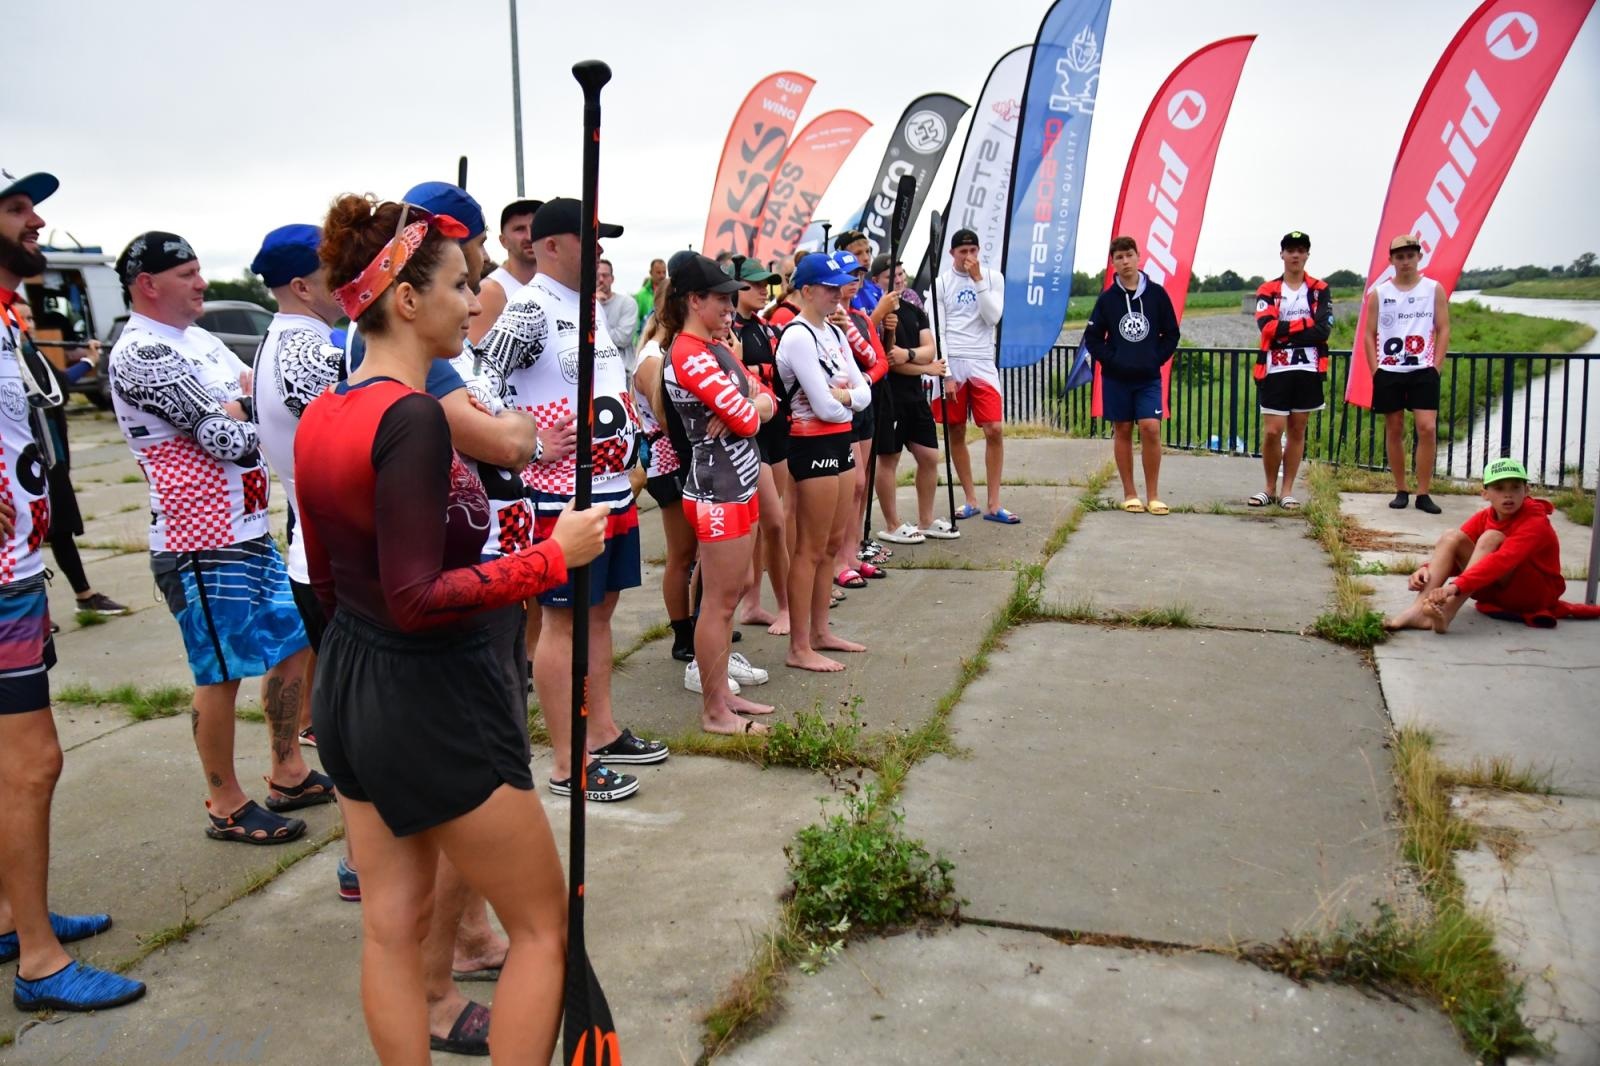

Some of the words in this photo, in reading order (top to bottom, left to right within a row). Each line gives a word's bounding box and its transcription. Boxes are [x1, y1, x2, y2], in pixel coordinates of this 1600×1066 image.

[775, 77, 803, 95] SUP
[762, 97, 798, 121] WING
[1367, 67, 1501, 295] apid
[762, 161, 804, 239] BASS
[1051, 196, 1069, 292] INNOVATION
[1062, 131, 1078, 192] QUALITY
[1142, 139, 1190, 287] pid
[1271, 348, 1310, 366] RA
[1383, 335, 1425, 356] OD
[720, 437, 761, 488] LAND
[710, 507, 725, 538] SKA
[585, 792, 613, 800] rocs
